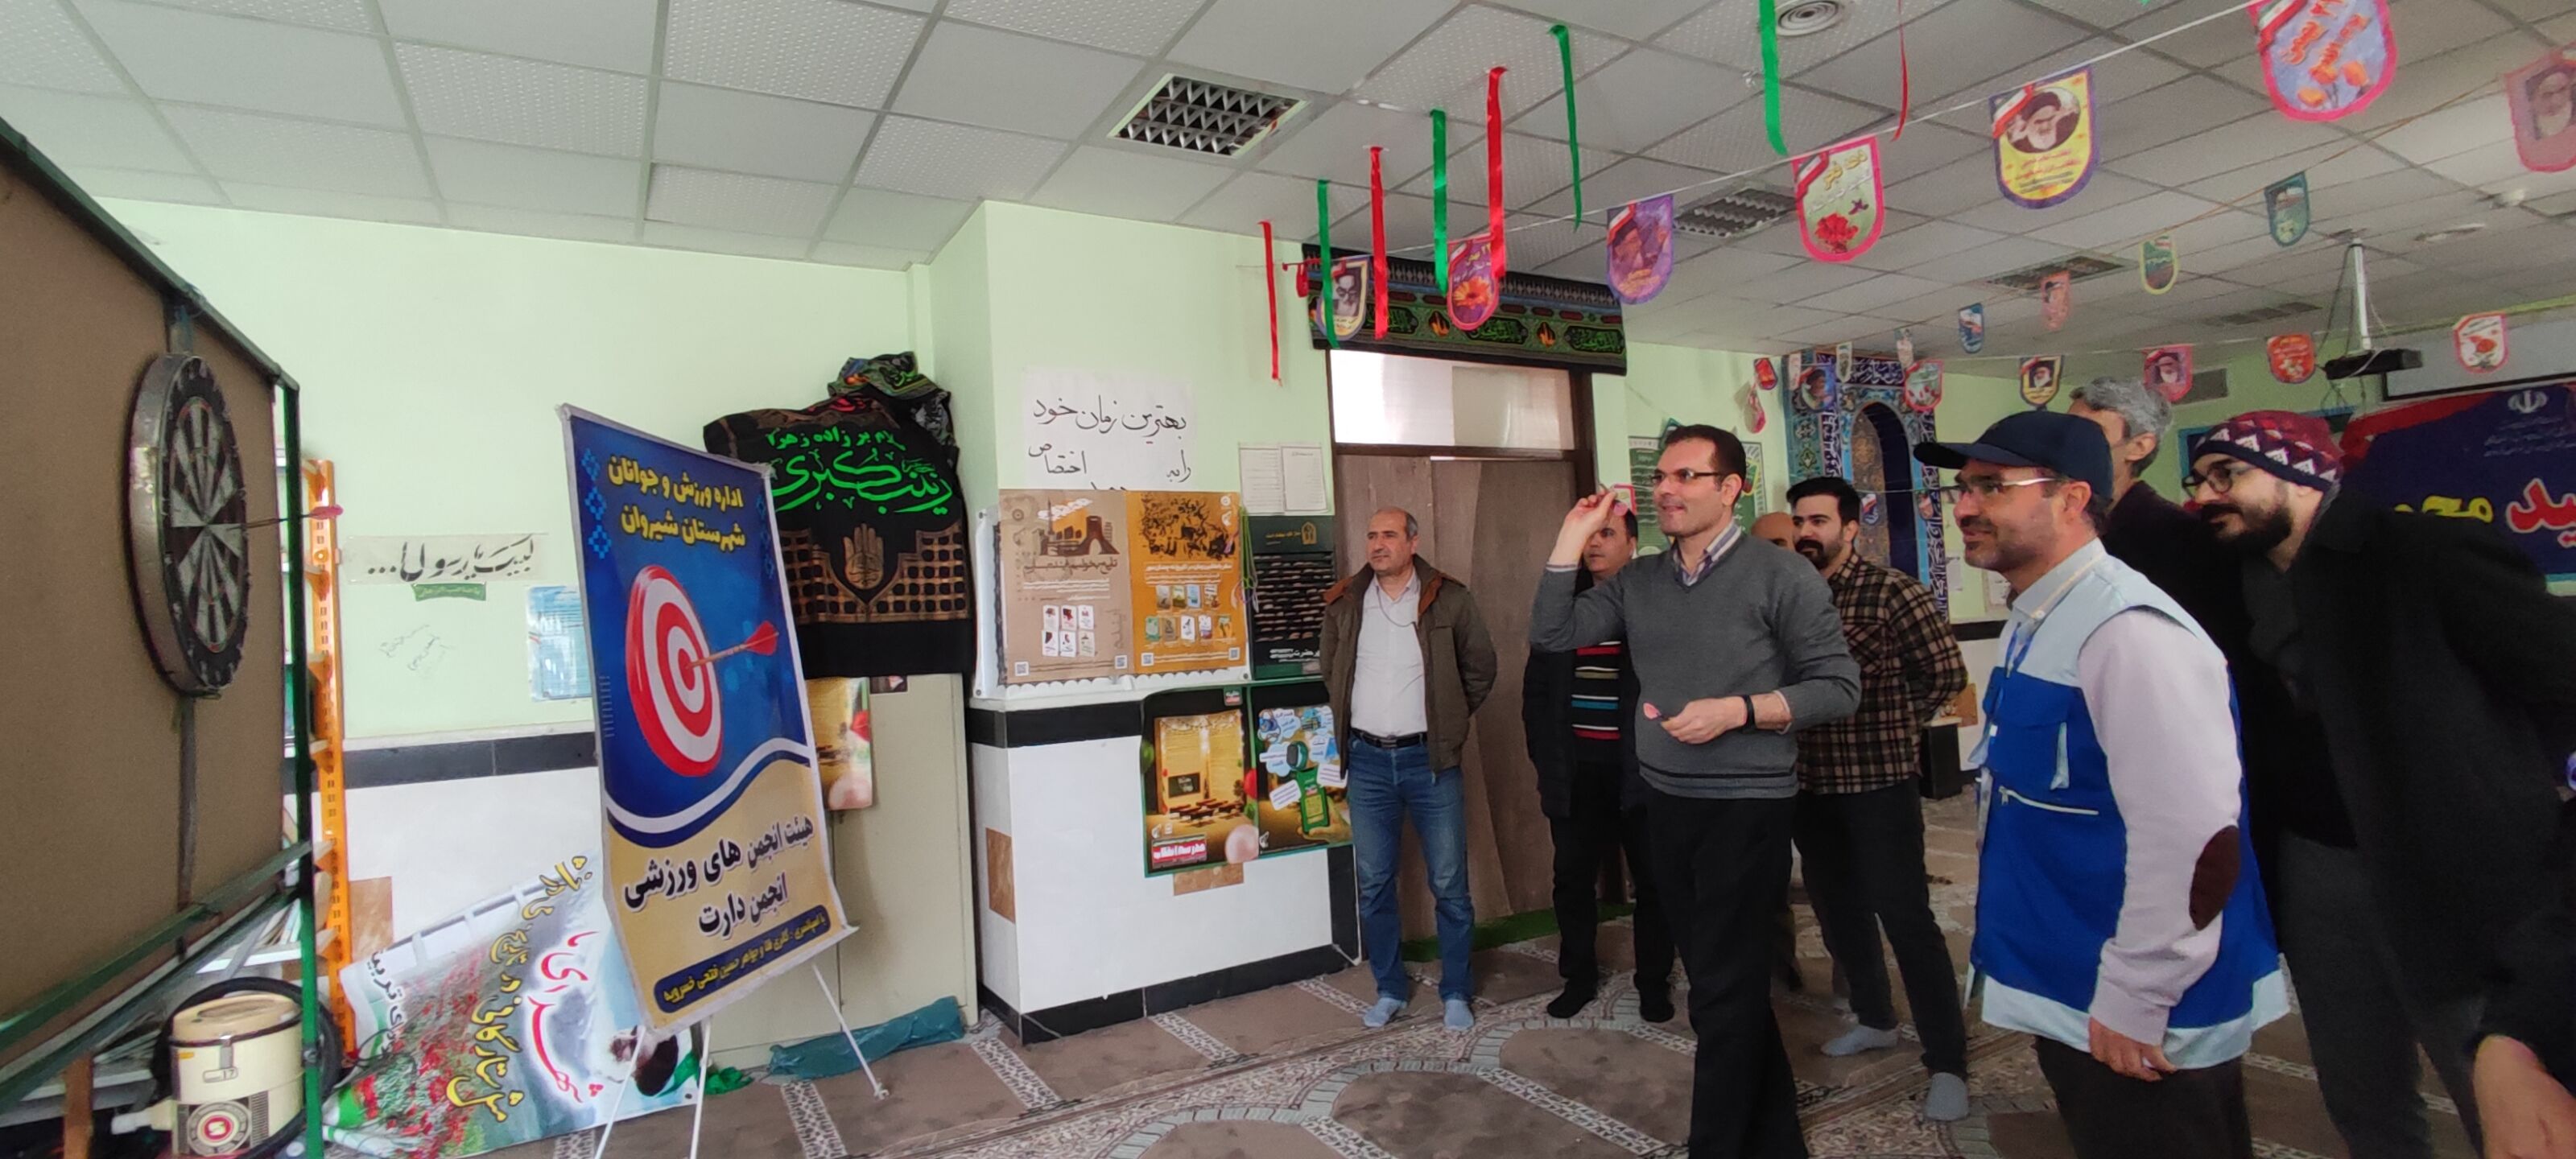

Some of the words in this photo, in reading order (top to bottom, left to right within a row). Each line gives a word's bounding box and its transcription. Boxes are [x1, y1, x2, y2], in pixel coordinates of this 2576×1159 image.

[1033, 398, 1079, 424] خود
[608, 456, 658, 494] جوانان
[662, 476, 670, 498] و
[673, 471, 712, 508] ورزش
[713, 485, 744, 513] اداره
[621, 505, 679, 540] شیروان
[682, 518, 745, 552] شهرستان
[748, 823, 782, 868] انجمن
[784, 815, 814, 846] هیئت
[704, 839, 741, 882] های
[625, 858, 696, 908] ورزشی
[751, 872, 787, 922] انجمن
[699, 893, 745, 936] دارت
[499, 973, 522, 994] در
